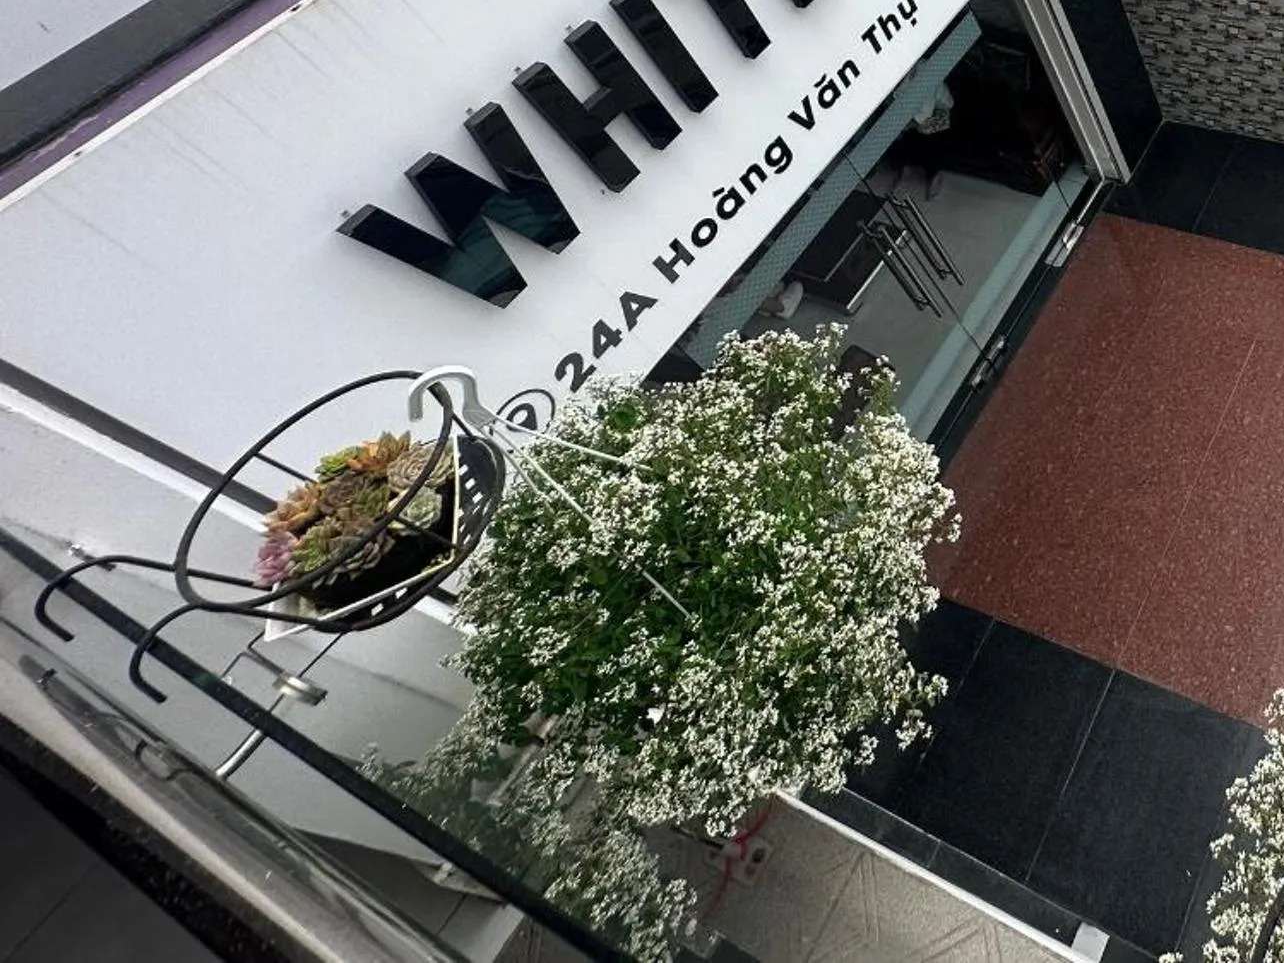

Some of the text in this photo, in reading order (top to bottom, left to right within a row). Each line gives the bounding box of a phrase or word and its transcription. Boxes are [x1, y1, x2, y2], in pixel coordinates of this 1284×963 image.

[554, 291, 659, 393] 24A
[652, 135, 794, 284] Hoàng
[787, 59, 861, 131] Văn
